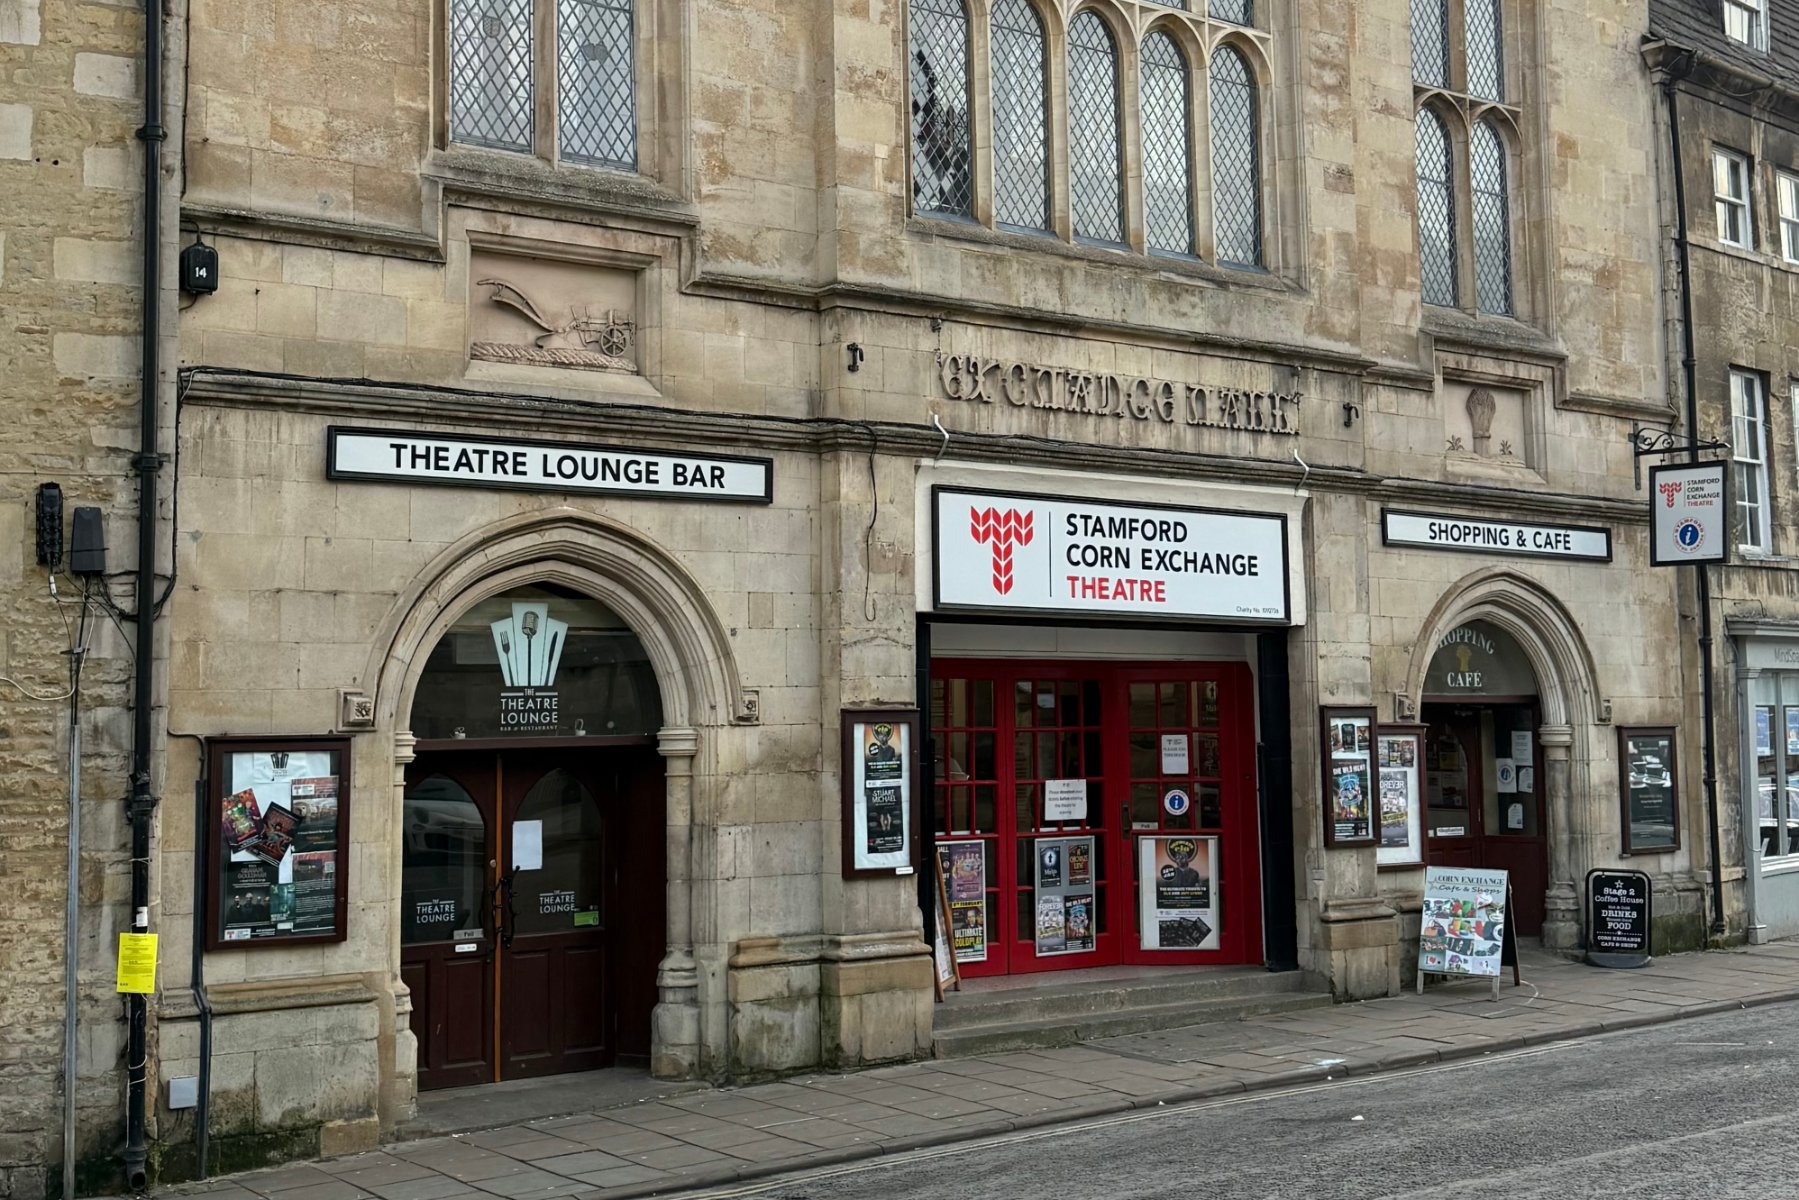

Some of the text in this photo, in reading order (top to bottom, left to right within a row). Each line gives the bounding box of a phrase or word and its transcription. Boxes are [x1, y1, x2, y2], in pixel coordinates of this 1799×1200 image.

[195, 266, 207, 278] 14
[940, 355, 1299, 434] EXCHANGE HALL
[389, 443, 726, 489] THEATRE LOUNGE BAR
[1687, 477, 1720, 486] STAMFORD
[1687, 492, 1720, 500] EXCHANGE
[1066, 512, 1188, 544] STAMFORD
[1428, 522, 1571, 551] SHOPPING & CAFÉ
[1066, 543, 1259, 577] CORN EXCHANGE
[1066, 575, 1167, 603] THEATRE
[1439, 628, 1496, 654] HOPPING
[1447, 670, 1482, 687] CAFÉ
[524, 688, 535, 696] THE
[500, 697, 558, 710] THEATRE
[501, 712, 558, 724] LOUNGE
[872, 788, 895, 797] STUART
[872, 795, 896, 803] MICHAEL
[1461, 876, 1504, 885] EXCHANGE
[1472, 885, 1502, 894] Shops
[1603, 887, 1635, 896] Stage 2
[540, 895, 575, 905] THEATRE
[416, 904, 455, 914] THEATRE
[540, 904, 575, 914] LOUNGE
[1601, 910, 1637, 918] DRINKS
[416, 913, 455, 924] LOUNGE
[955, 928, 983, 937] ULTIMATE
